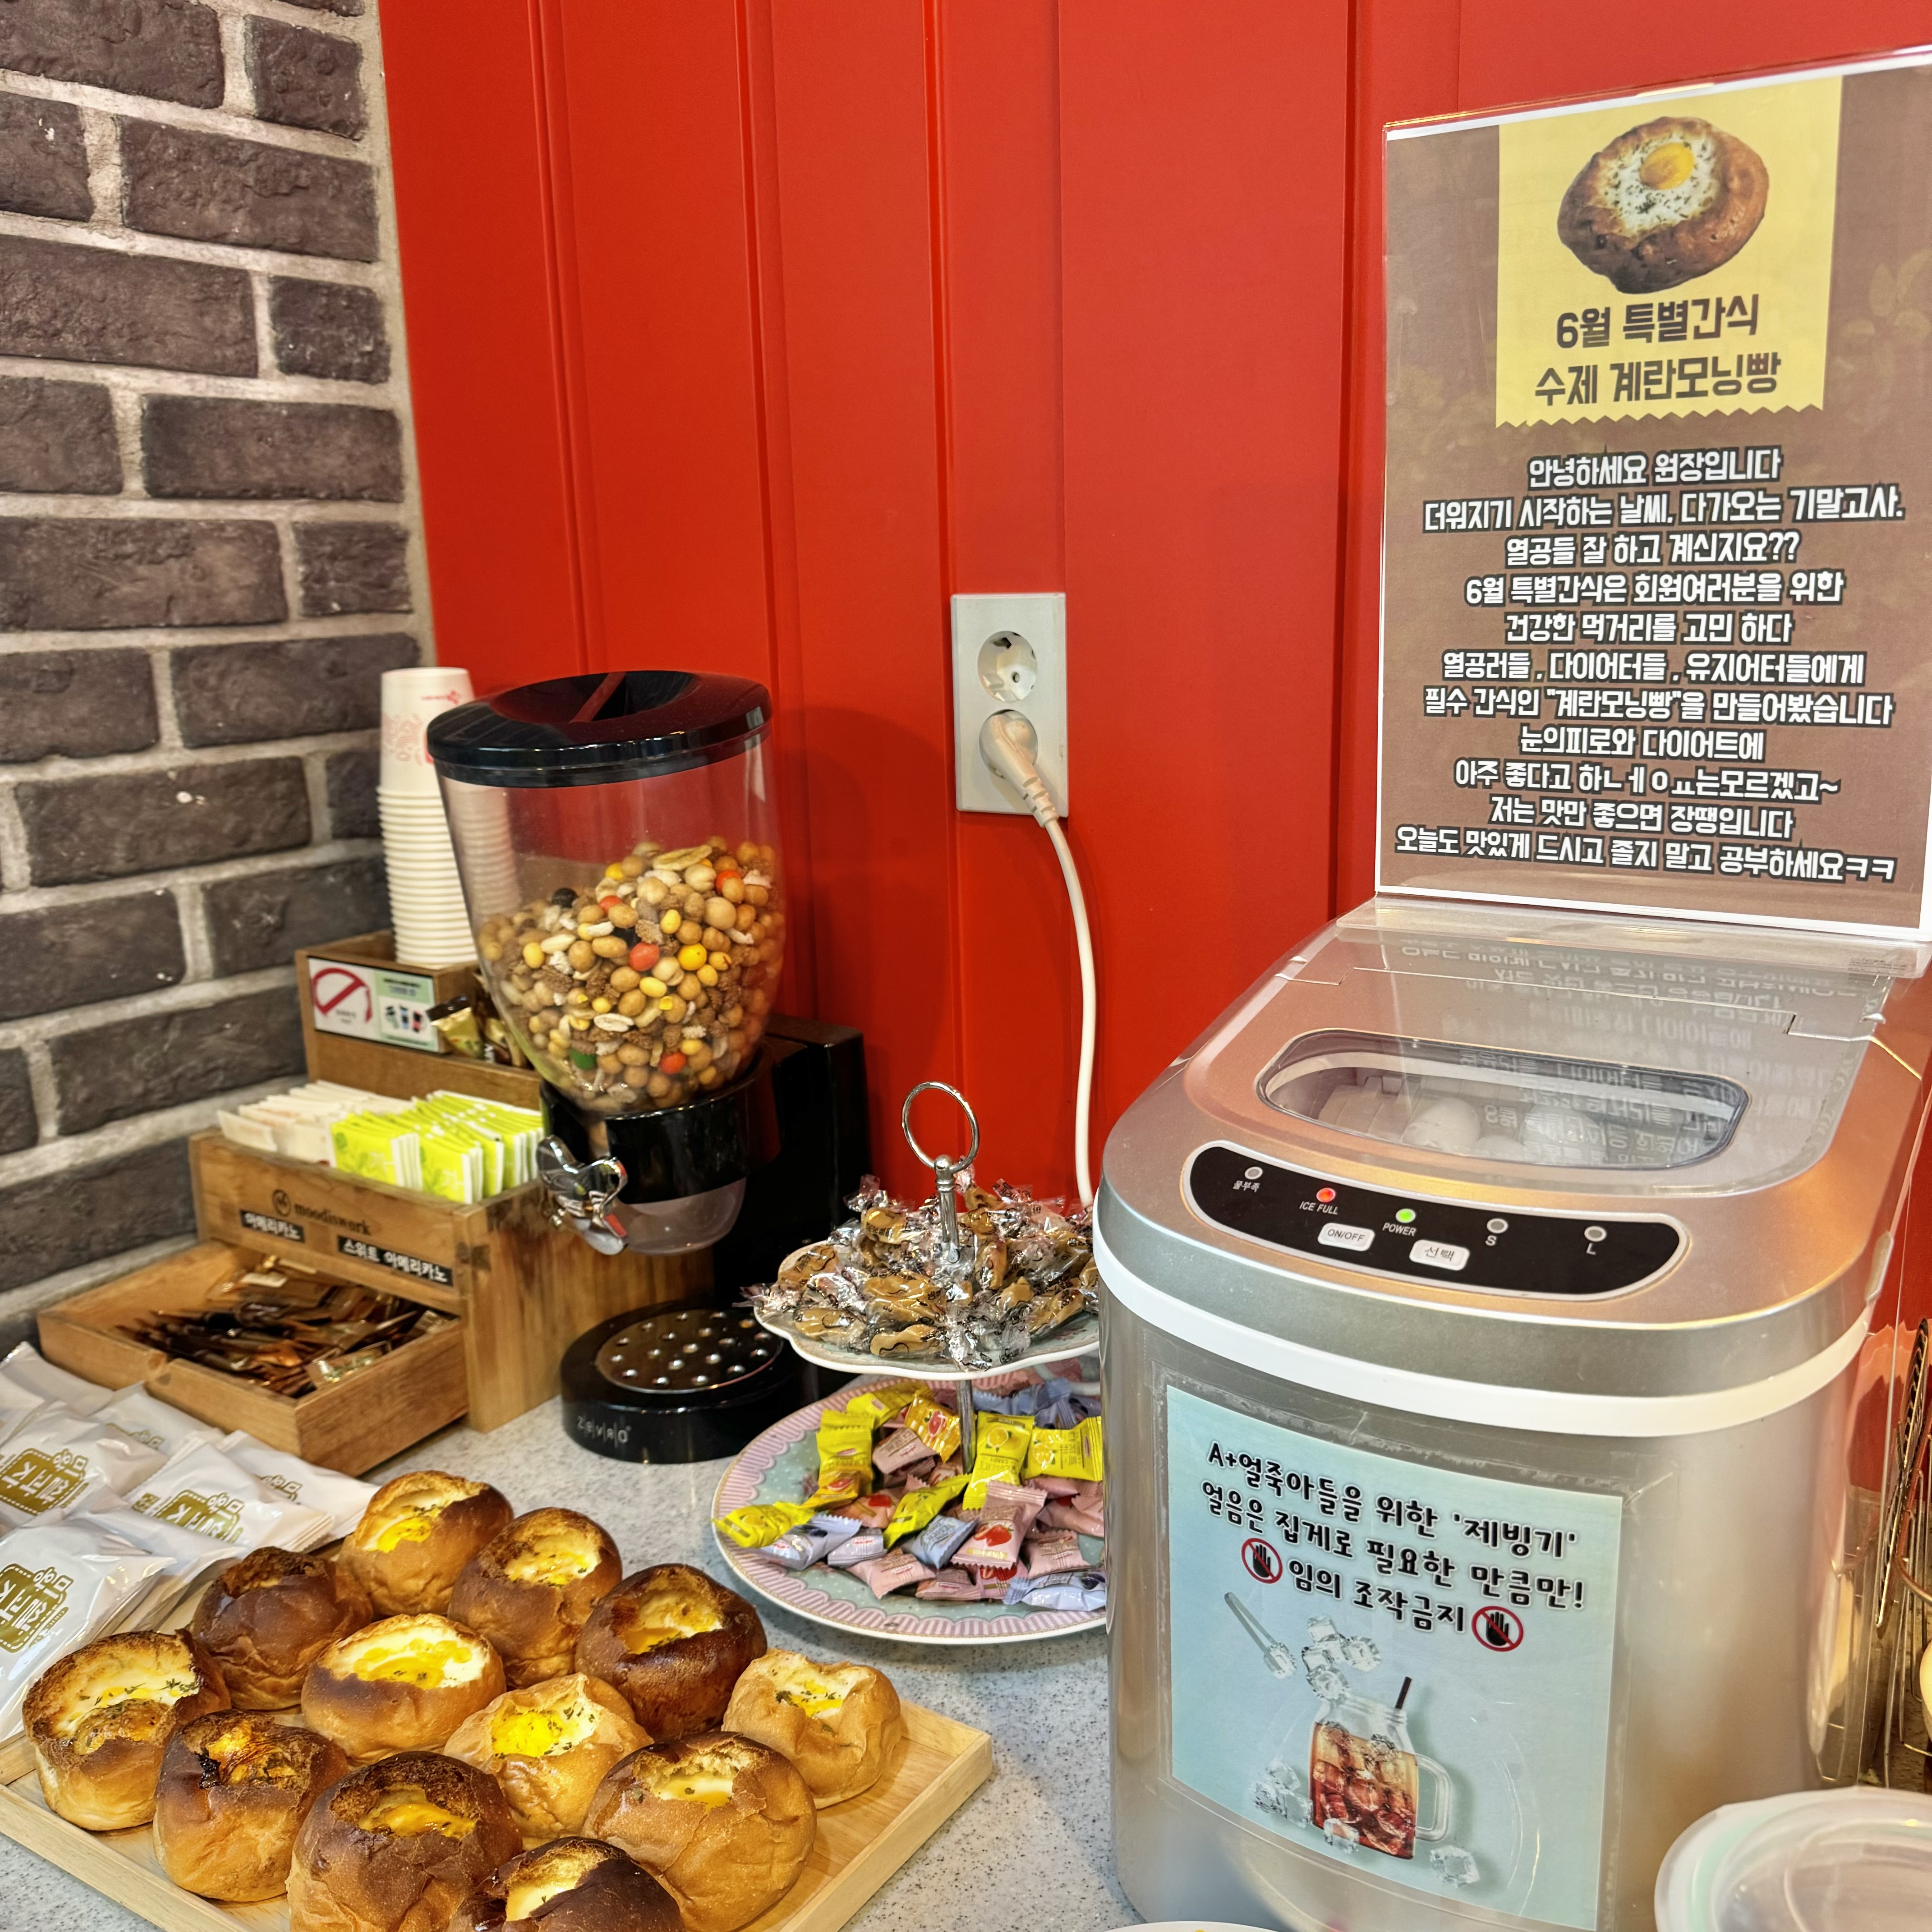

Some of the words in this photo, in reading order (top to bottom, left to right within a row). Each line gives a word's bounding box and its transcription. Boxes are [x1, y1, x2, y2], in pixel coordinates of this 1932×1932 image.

[1556, 306, 1611, 349] 6월
[1623, 293, 1759, 343] 특별간식
[1535, 364, 1598, 406] 수제
[1610, 352, 1781, 402] 계란모닝빵
[1528, 453, 1648, 489] 안녕하세요
[1653, 447, 1782, 483] 원장입니다
[1424, 497, 1513, 531] 더워지기
[1518, 494, 1613, 528] 시작하는
[1619, 492, 1674, 524] 날씨,
[1680, 489, 1782, 523] 다가오는
[1789, 484, 1904, 521] 기말고사.
[1506, 535, 1576, 567] 열공들
[1582, 534, 1607, 565] 잘
[1613, 533, 1662, 565] 하고
[1668, 530, 1801, 563] 계신지요??
[1465, 575, 1505, 605] 6월
[1509, 573, 1628, 604] 특별간식은
[1633, 571, 1783, 603] 회원여러분을
[1789, 570, 1845, 603] 위한
[1505, 612, 1577, 643] 건강한
[1581, 612, 1677, 643] 먹거리를
[1682, 612, 1734, 643] 고민
[1740, 612, 1794, 644] 하다
[1442, 650, 1532, 680] 열공러들
[1549, 651, 1668, 681] 다이어터들
[1684, 652, 1865, 685] 유지어터들에게
[1424, 687, 1468, 715] 필수
[1472, 687, 1540, 717] 간식인
[1712, 691, 1894, 726] 만들어봤습니다
[1519, 725, 1637, 756] 눈의피로와
[1642, 728, 1765, 761] 다이어트에
[1454, 758, 1500, 787] 아주
[1504, 760, 1572, 791] 좋다고
[1490, 796, 1535, 824] 저는
[1540, 798, 1587, 828] 맛만
[1592, 801, 1663, 833] 좋으면
[1670, 805, 1794, 839] 장땡입니다
[1396, 825, 1460, 855] 오늘도
[1464, 829, 1531, 859] 맛있게
[1535, 833, 1605, 865] 드시고
[1610, 838, 1658, 868] 졸지
[1664, 842, 1713, 872] 말고
[1719, 844, 1895, 881] 공부하세요ㅋㅋ
[1233, 1179, 1261, 1193] 물부족
[1299, 1201, 1316, 1212] ICE
[1316, 1204, 1339, 1215] FULL
[244, 1212, 302, 1241] 아메리카노
[1327, 1229, 1366, 1243] ON/OFF
[1382, 1223, 1417, 1237] POWER
[1485, 1235, 1498, 1247] S
[343, 1237, 381, 1263] 스위트
[383, 1251, 449, 1284] 아메리카노
[1424, 1246, 1455, 1262] 선택
[1585, 1243, 1597, 1255] L
[1207, 1442, 1363, 1523] A+얼죽아들을
[1375, 1496, 1439, 1538] 위한
[1452, 1513, 1577, 1558] '제빙기'
[1202, 1481, 1264, 1534] 얼음은
[1274, 1510, 1354, 1558] 집게로
[1366, 1540, 1455, 1588] 필요한
[1471, 1566, 1584, 1609] 만큼만!
[1289, 1560, 1341, 1599] 임의
[1353, 1581, 1464, 1632] 조작금지
